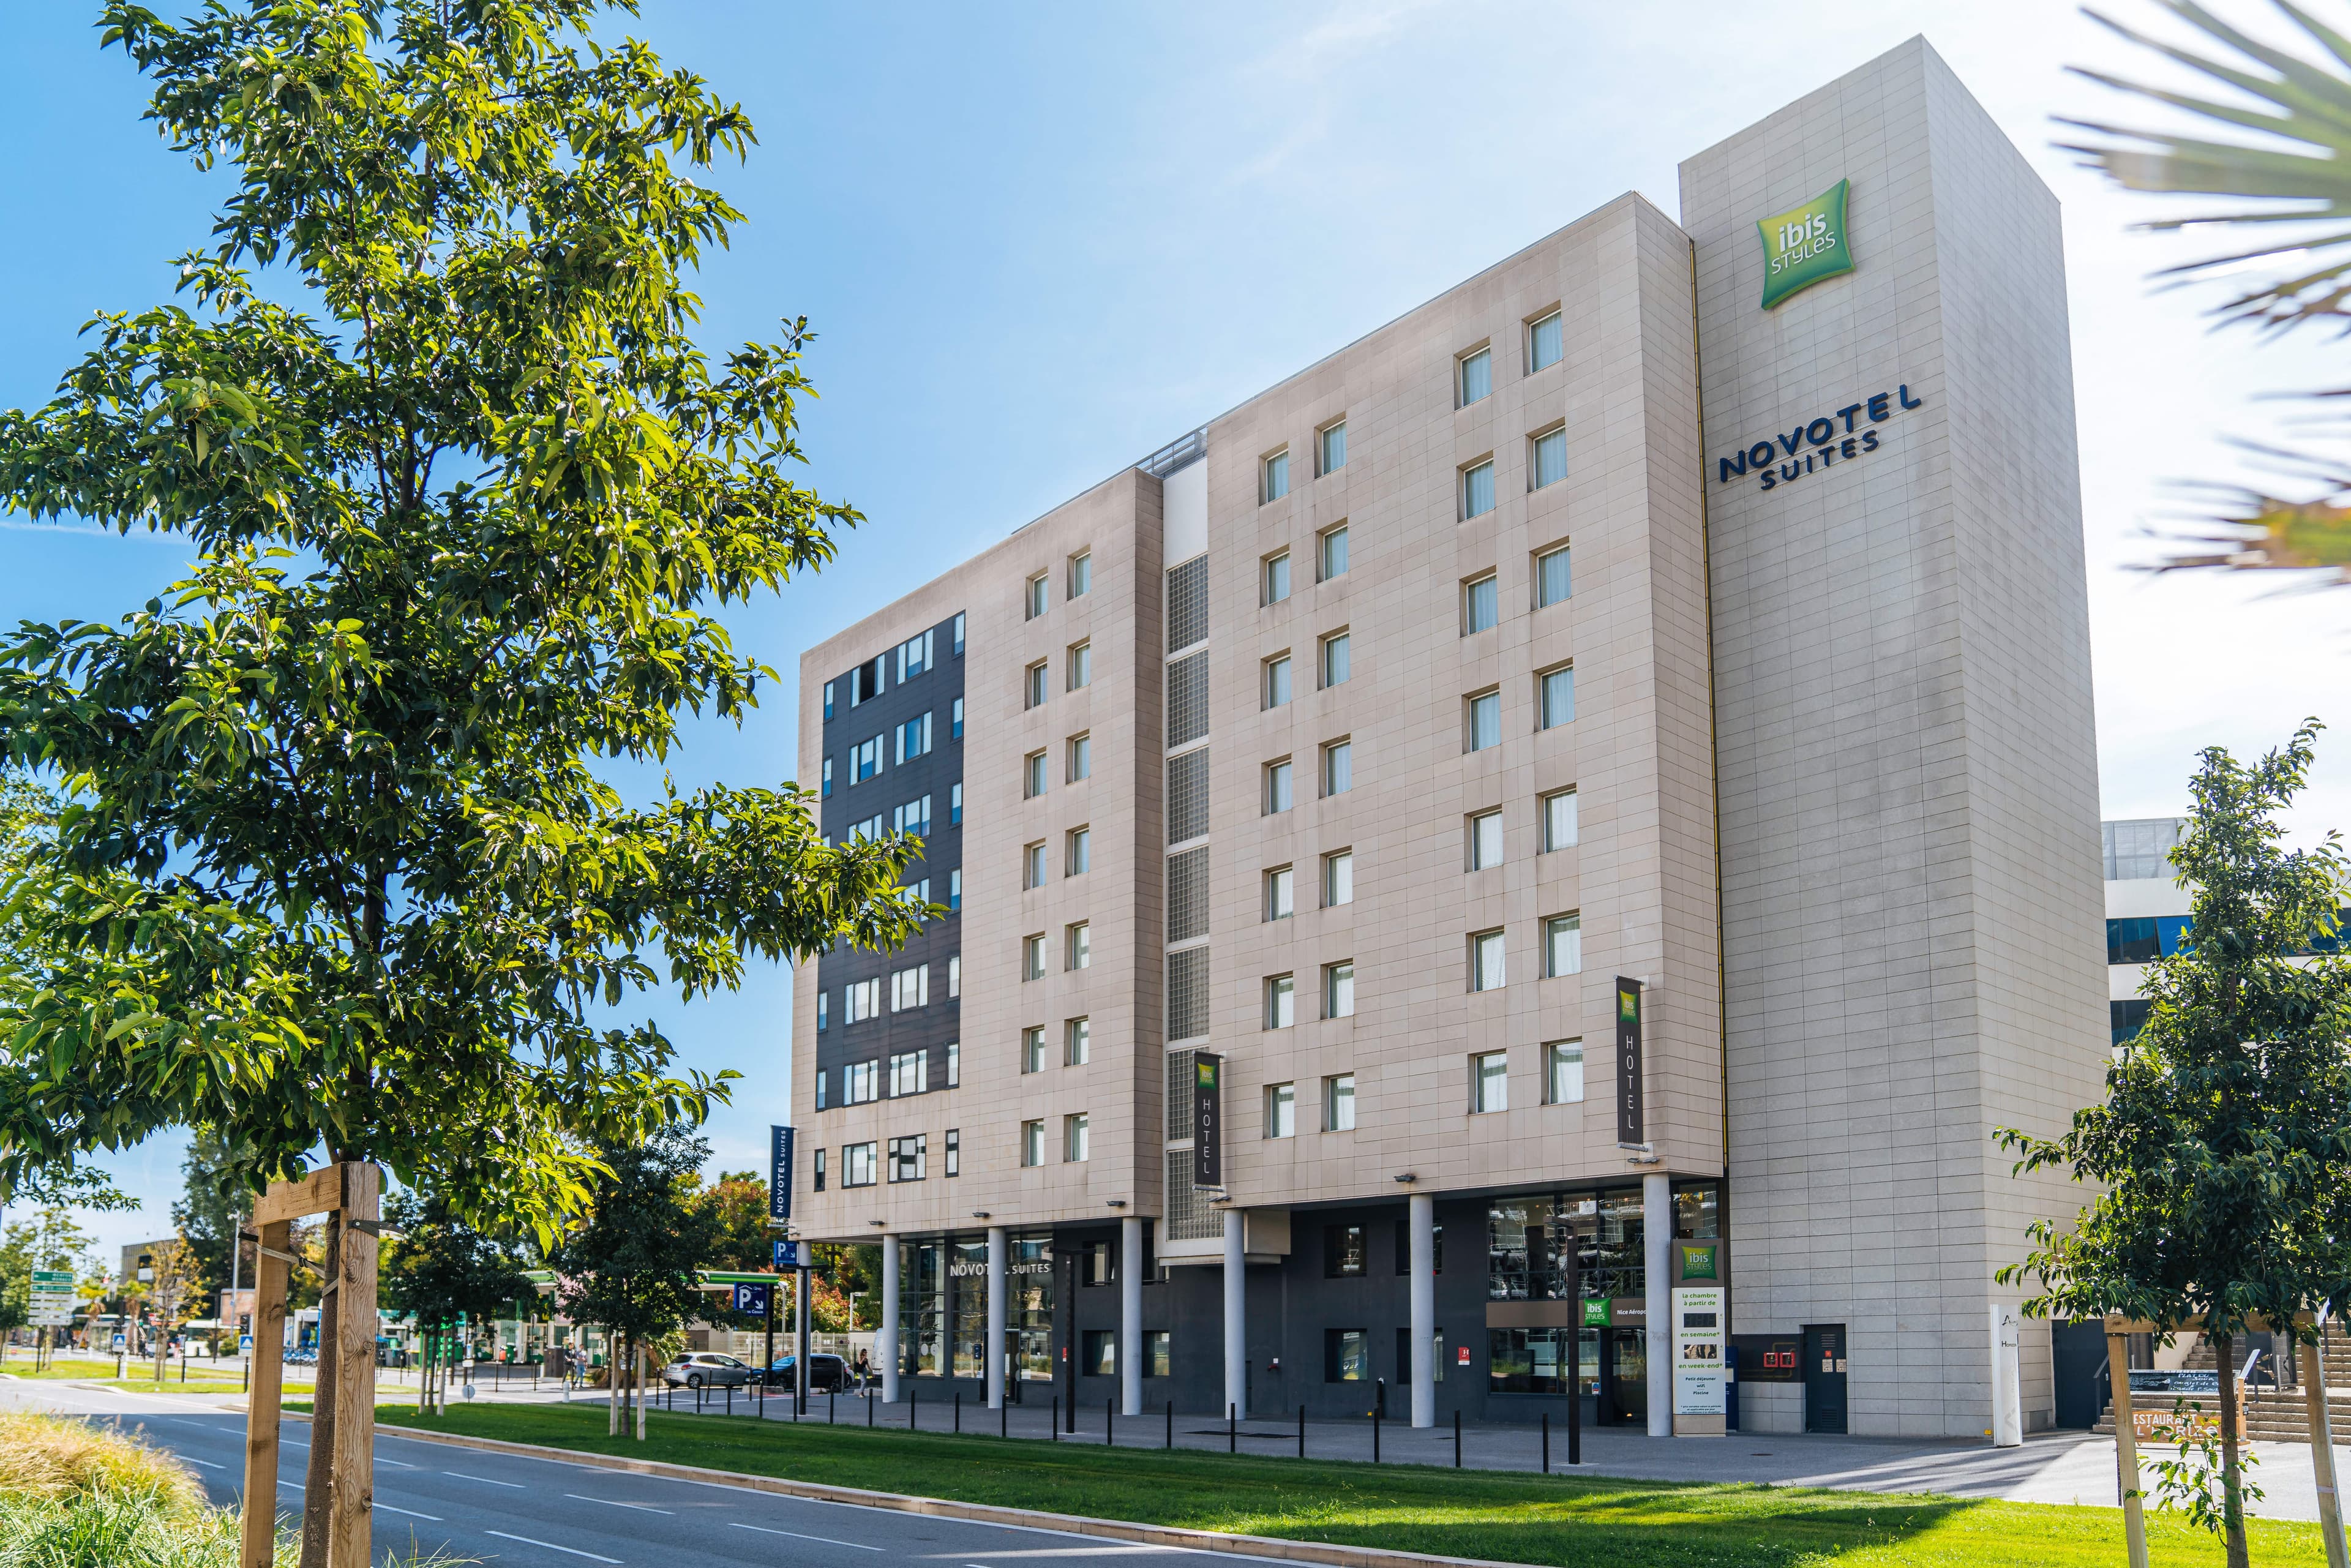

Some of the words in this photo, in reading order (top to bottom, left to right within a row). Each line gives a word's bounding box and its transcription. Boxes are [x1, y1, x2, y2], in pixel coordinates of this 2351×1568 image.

[1779, 213, 1827, 252] ibis
[1719, 383, 1922, 484] NOVOTEL
[1760, 429, 1880, 490] SUITES
[1624, 999, 1634, 1009] ibis
[1202, 1070, 1212, 1078] ibis
[778, 1243, 787, 1258] P
[1689, 1252, 1709, 1262] ibis
[1012, 1263, 1049, 1274] SUITES
[739, 1289, 751, 1309] P
[1587, 1303, 1602, 1313] ibis
[2133, 1413, 2197, 1425] ESTAURANT
